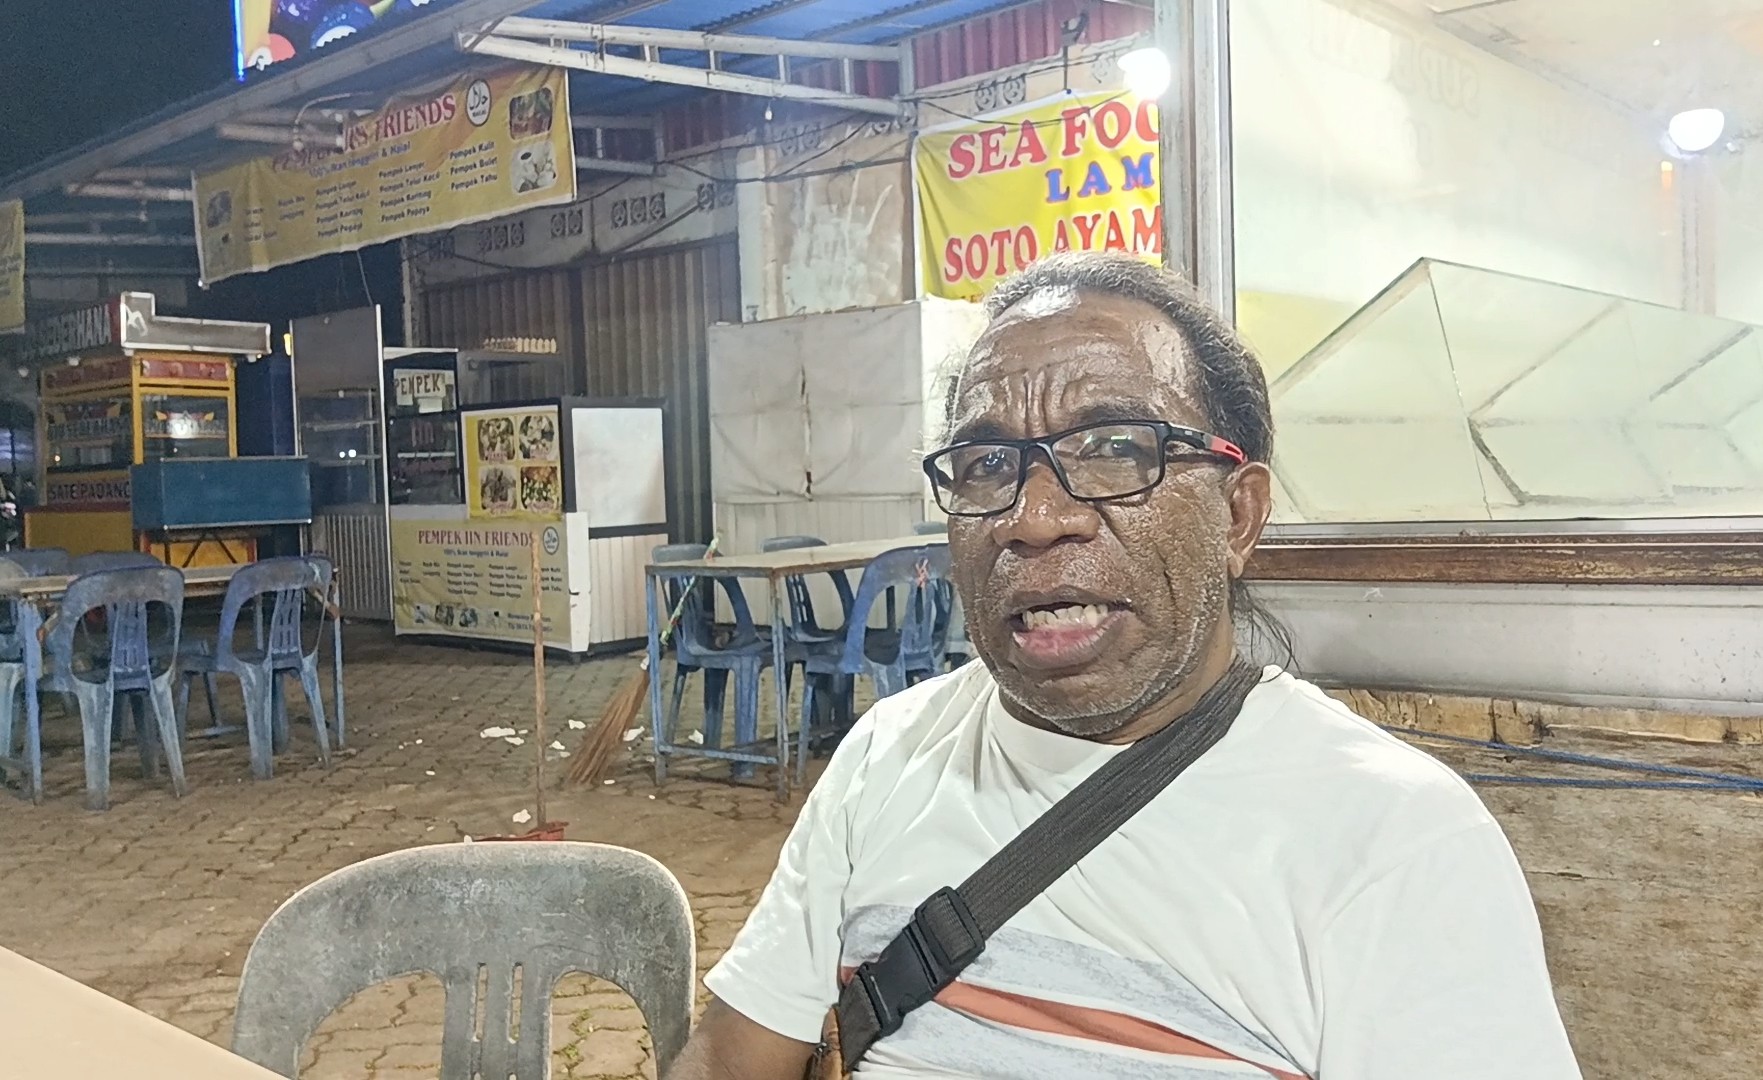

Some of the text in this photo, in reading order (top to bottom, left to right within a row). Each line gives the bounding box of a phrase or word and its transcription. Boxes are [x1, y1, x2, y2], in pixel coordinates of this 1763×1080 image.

[948, 119, 1047, 179] SEA
[944, 205, 1162, 283] SOTO AYAM
[50, 484, 76, 499] SATE
[418, 530, 462, 545] PEMPEK
